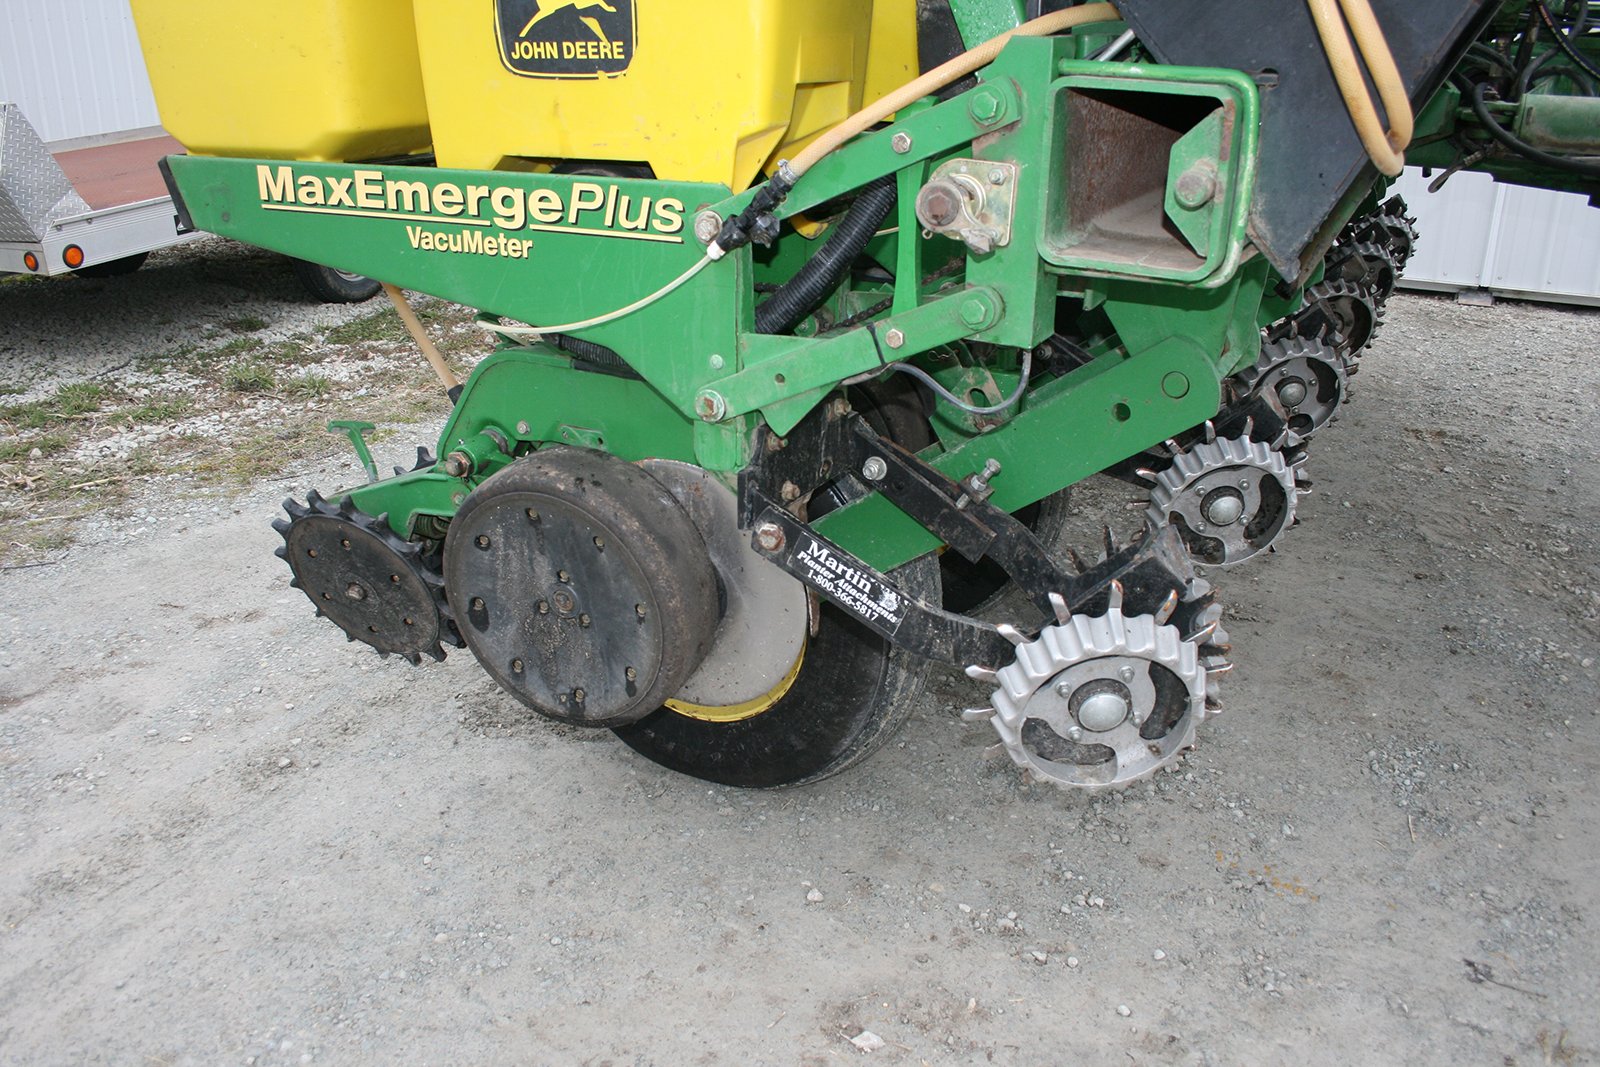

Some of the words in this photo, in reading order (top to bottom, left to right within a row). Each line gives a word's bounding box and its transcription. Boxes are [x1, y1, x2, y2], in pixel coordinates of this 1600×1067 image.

[511, 41, 558, 60] JOHN
[562, 41, 625, 60] DEERE
[406, 226, 533, 259] VacuMeter
[797, 551, 836, 579] Planter
[834, 579, 898, 623] Attachments
[806, 540, 872, 594] Martin
[807, 569, 879, 621] 1-800-366-5817
